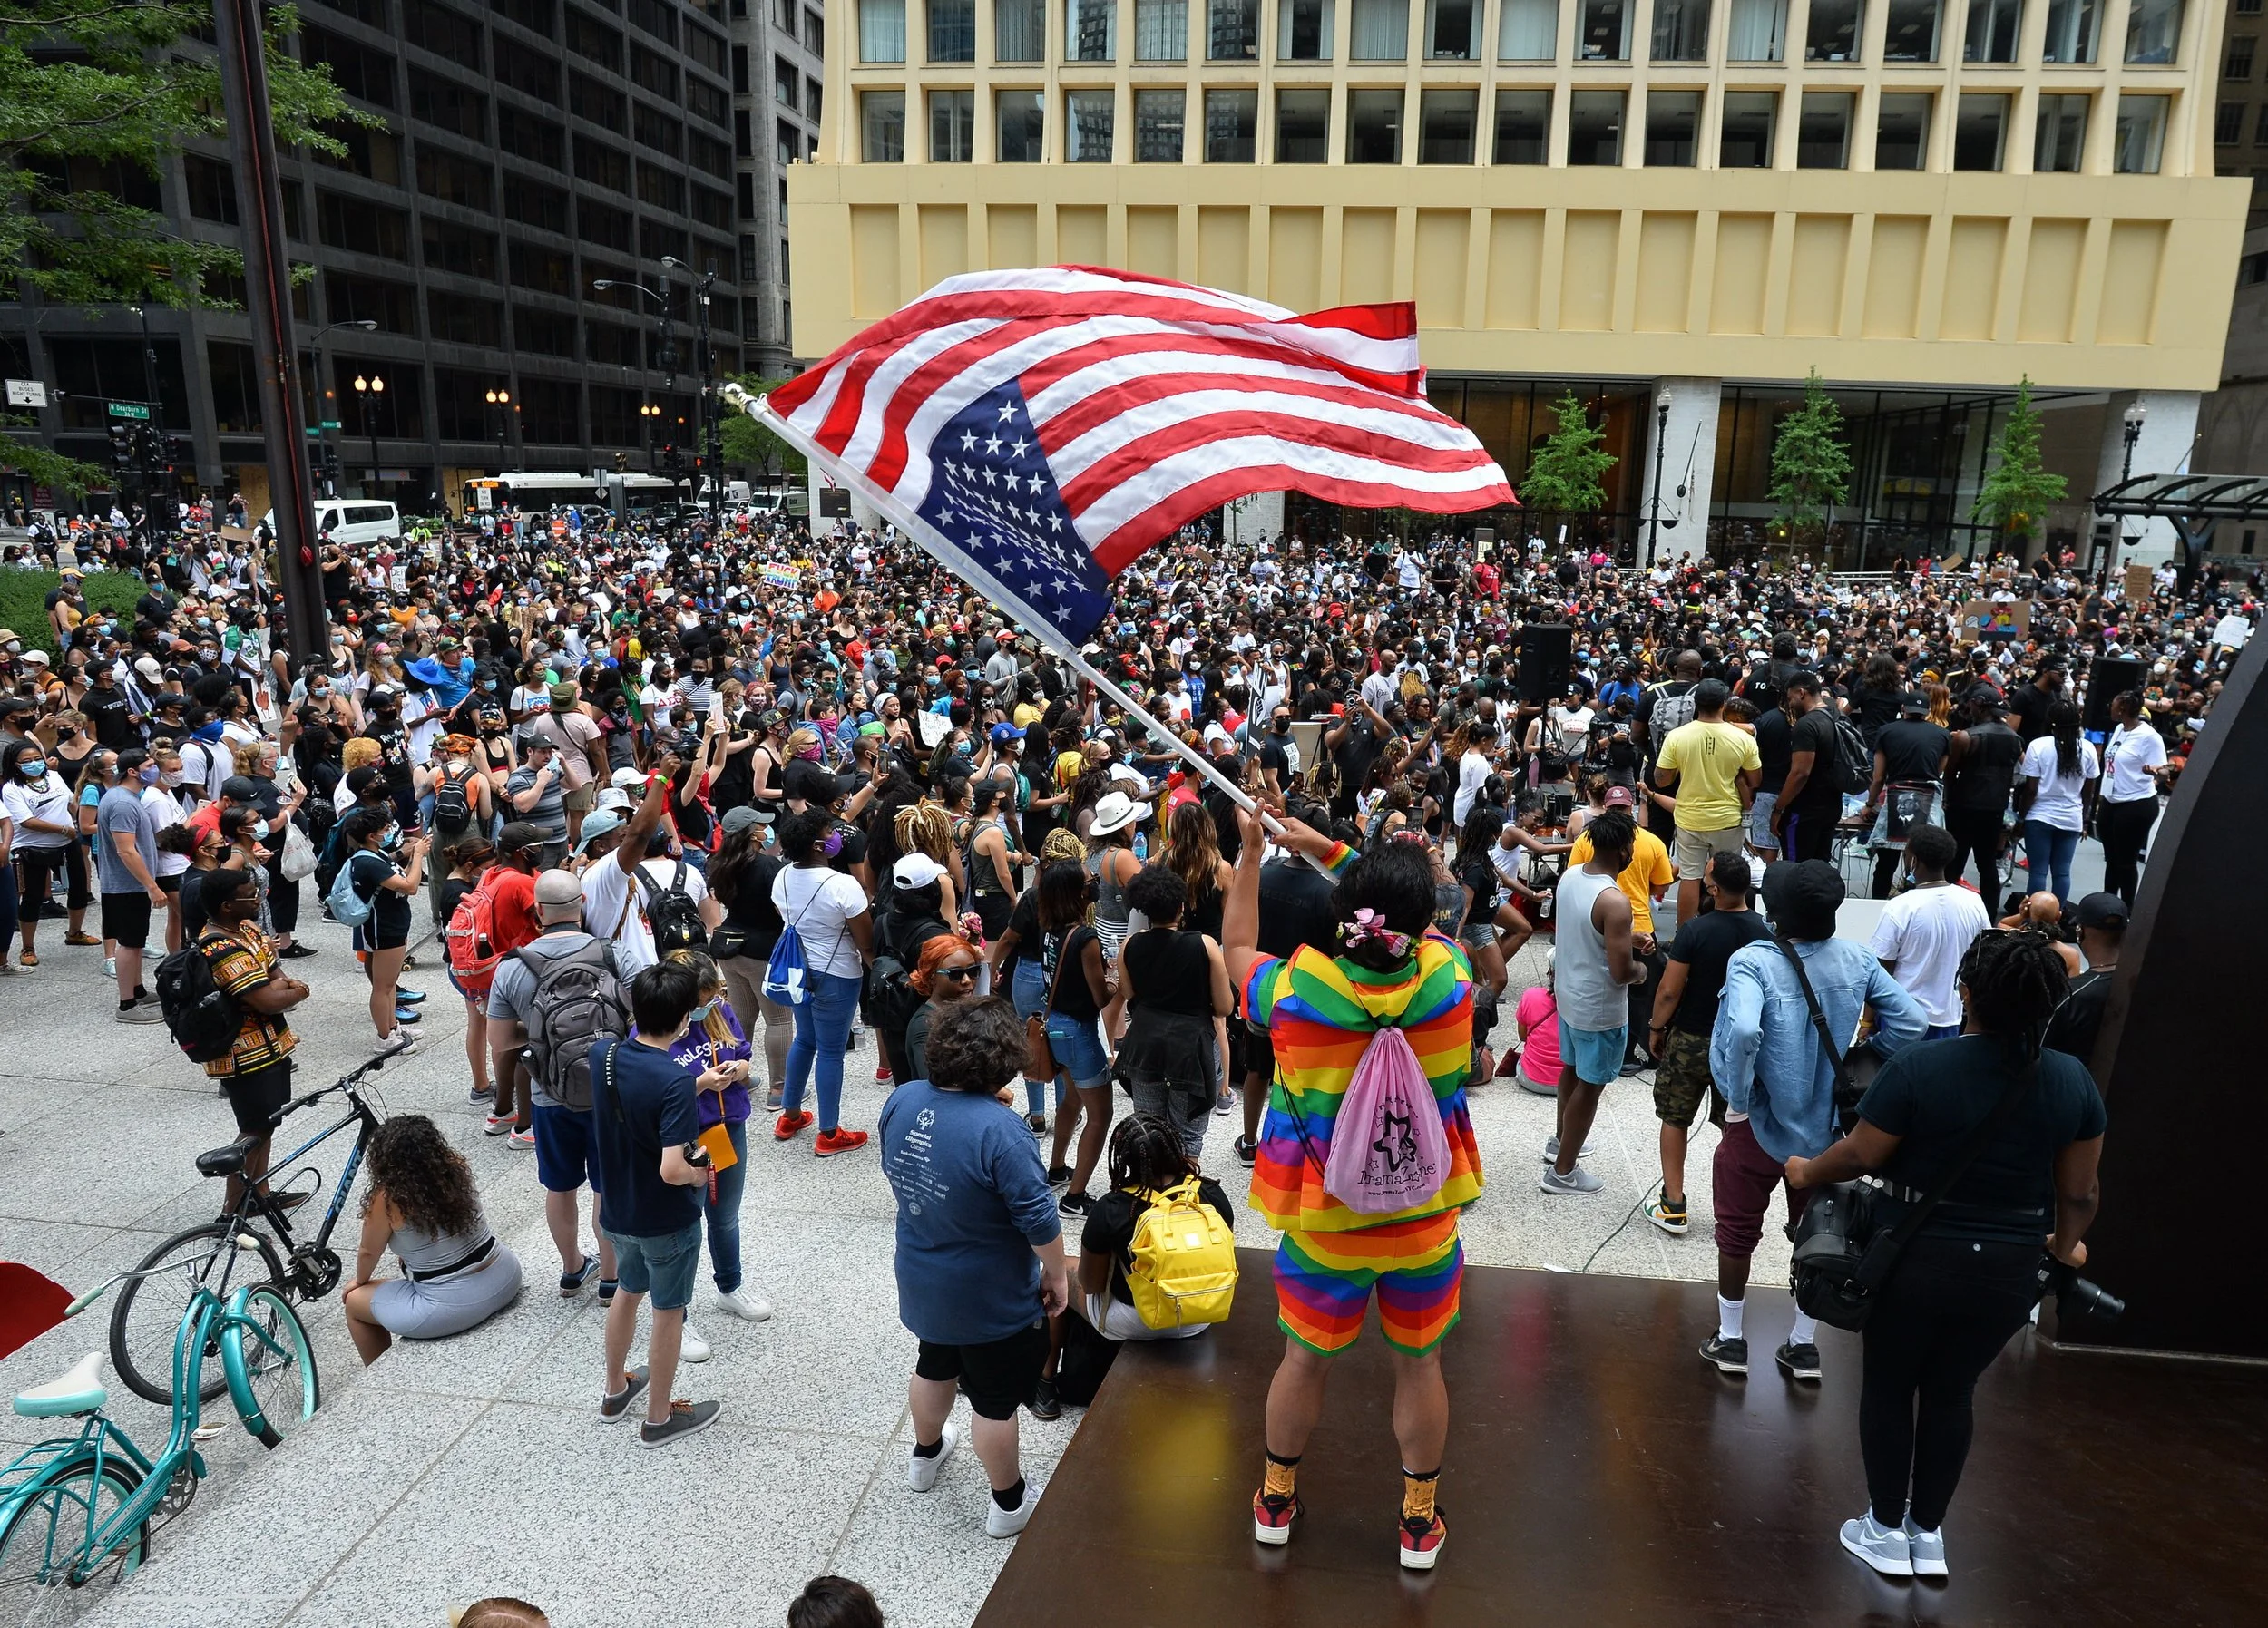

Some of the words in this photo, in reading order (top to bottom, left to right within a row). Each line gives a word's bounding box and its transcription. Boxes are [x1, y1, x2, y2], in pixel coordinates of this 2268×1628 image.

[116, 405, 140, 413] Dearborn
[768, 563, 798, 574] FUCK
[909, 1129, 932, 1141] Special
[904, 1135, 932, 1148] Olympics
[910, 1144, 926, 1153] Chicago
[334, 1150, 362, 1214] GIANT
